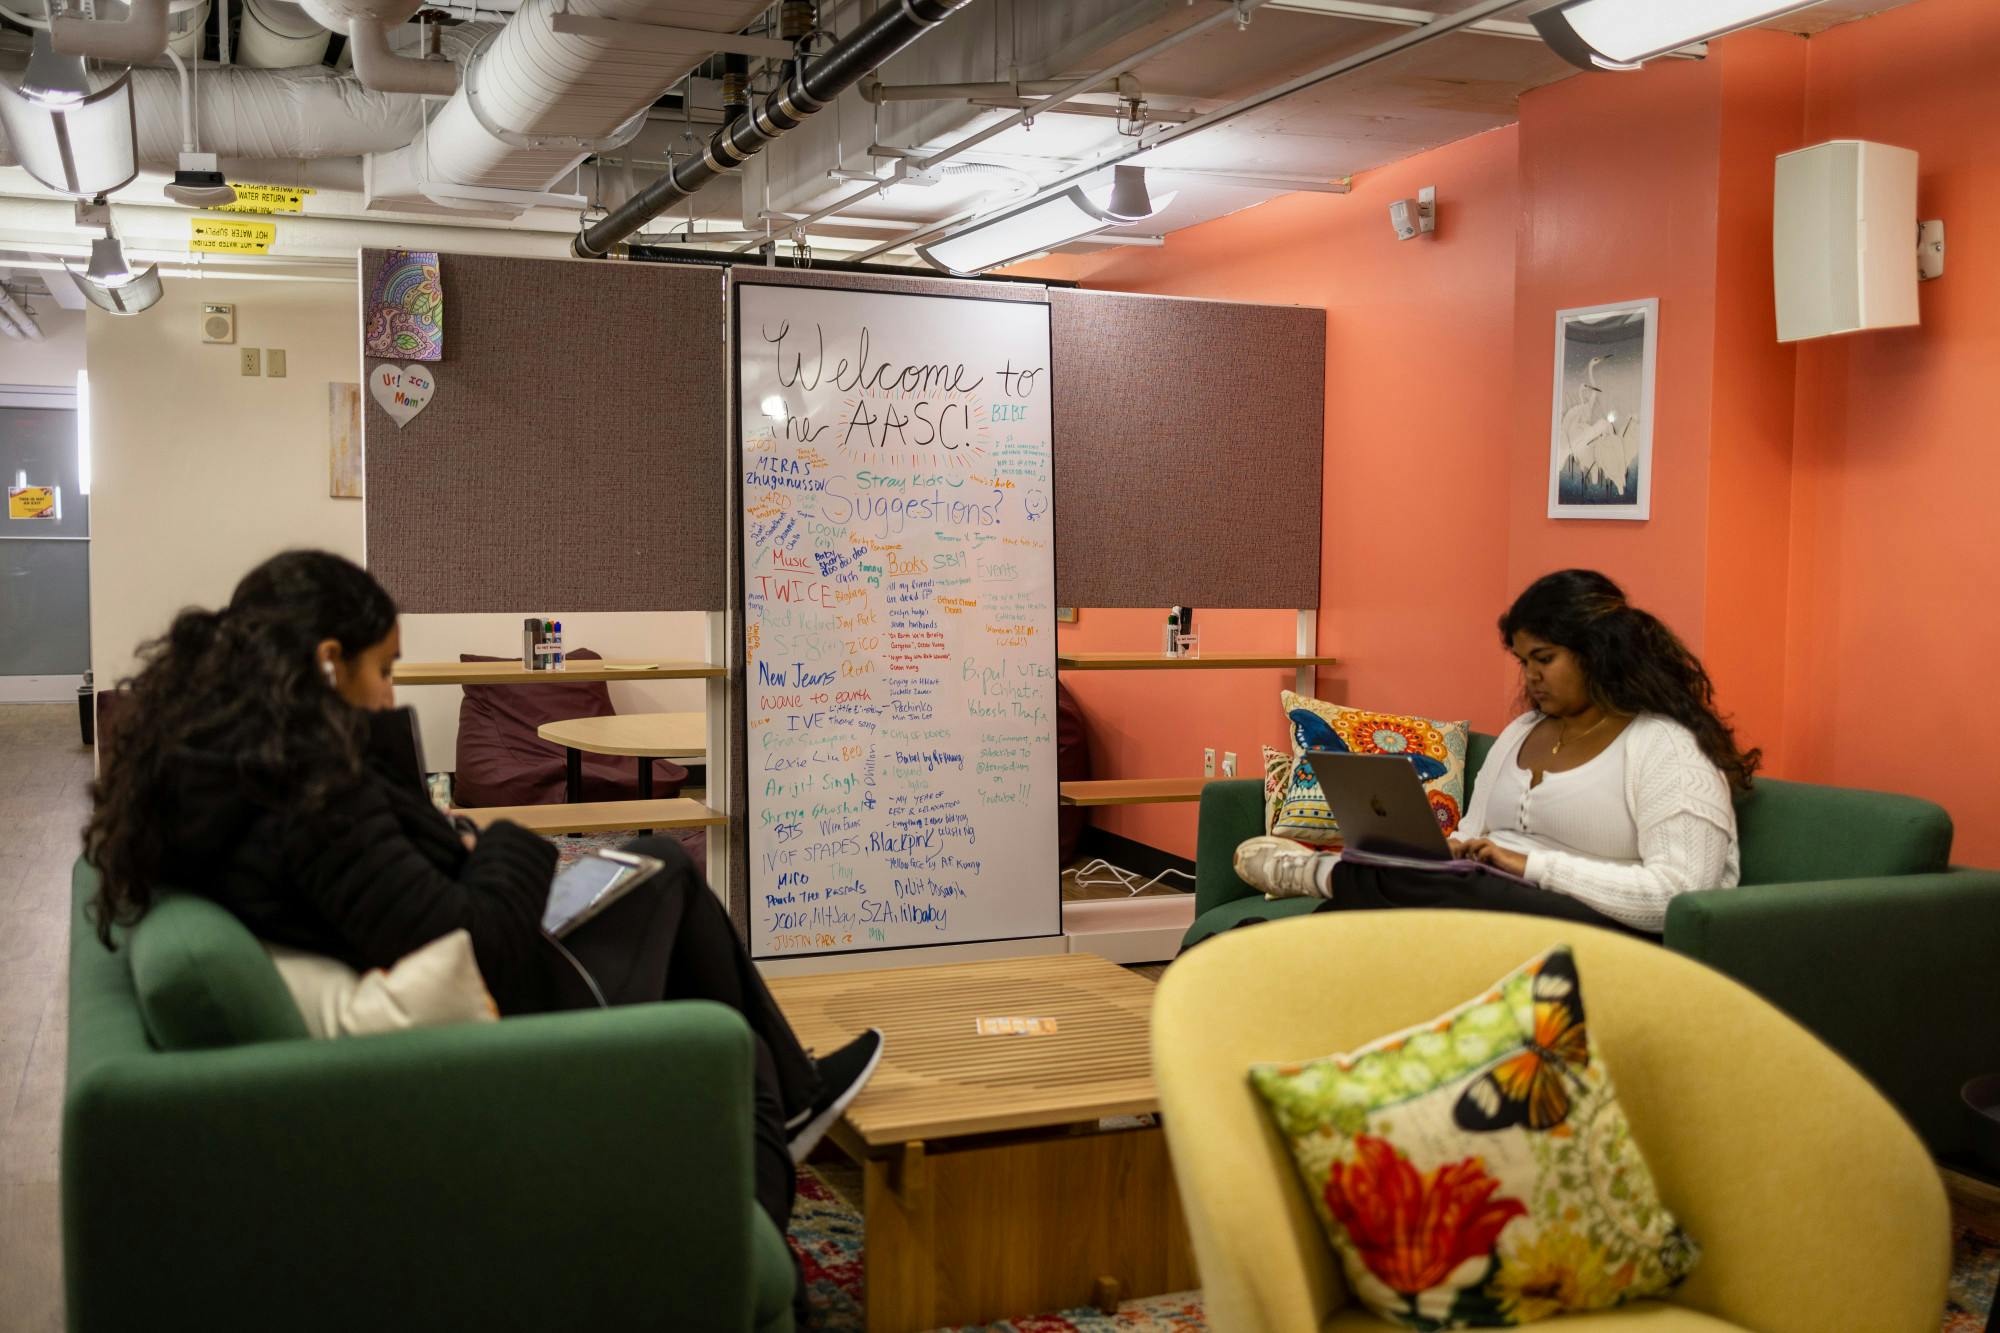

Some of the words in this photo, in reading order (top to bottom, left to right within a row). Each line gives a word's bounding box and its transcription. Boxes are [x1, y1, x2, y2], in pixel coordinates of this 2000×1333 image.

[238, 191, 259, 201] WATER
[262, 193, 286, 203] RETURN
[205, 227, 228, 237] SUPPLY
[231, 228, 252, 238] WATER
[256, 231, 269, 240] HOT
[762, 319, 984, 392] Welcome
[996, 359, 1044, 398] to
[991, 404, 1028, 423] BIBI
[844, 400, 971, 450] AASC!
[756, 455, 811, 476] MIRAS
[856, 471, 907, 495] Stray
[912, 474, 944, 488] Kids
[821, 475, 1004, 539] Suggestions?
[807, 521, 848, 538] LOONA
[773, 549, 812, 569] Music
[887, 552, 929, 574] Books
[754, 575, 837, 609] TWICE
[759, 660, 787, 688] New
[791, 662, 838, 689] Jeans
[809, 691, 829, 705] to
[774, 822, 804, 844] BTS
